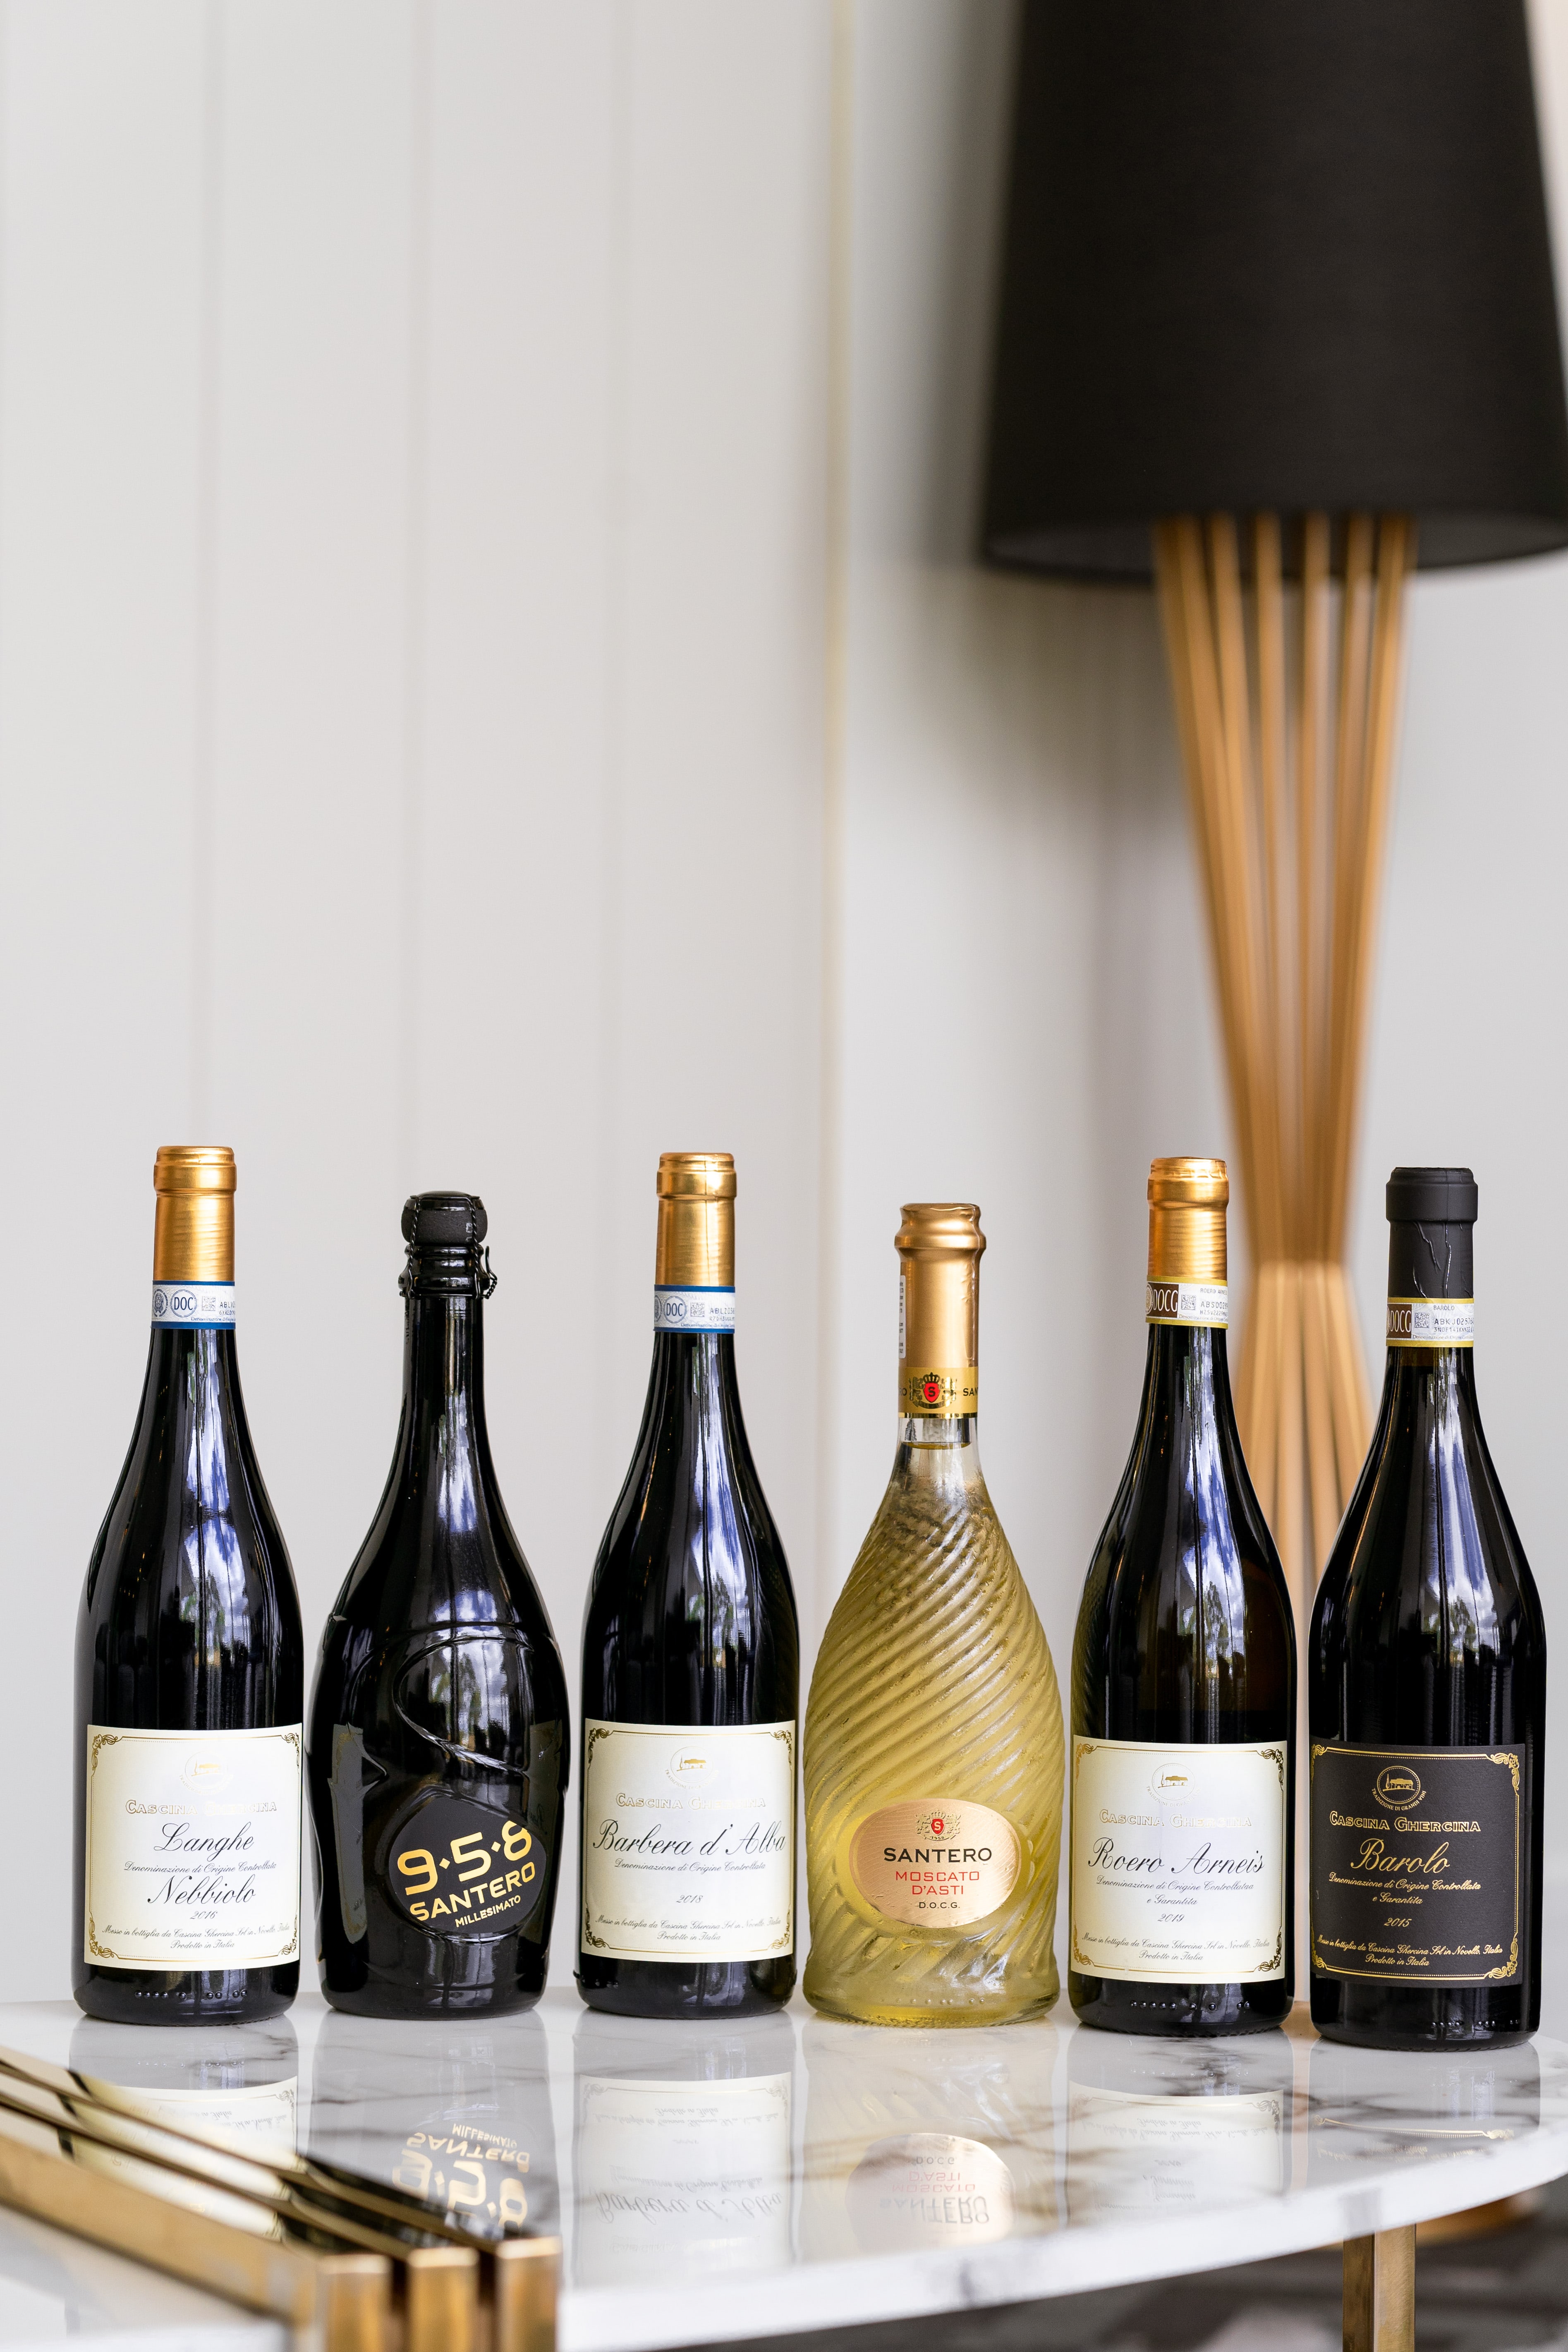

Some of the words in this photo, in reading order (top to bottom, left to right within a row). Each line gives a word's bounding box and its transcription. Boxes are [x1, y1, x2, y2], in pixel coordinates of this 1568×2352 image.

[174, 1297, 193, 1310] DOC
[1154, 1289, 1178, 1312] DOCG
[666, 1303, 683, 1316] DOC
[1391, 1310, 1411, 1332] DOCG
[615, 1793, 683, 1809] CASCINA
[1146, 1786, 1169, 1806] TRADIZIONE
[1372, 1788, 1394, 1810] TRADIZIONE
[1401, 1800, 1420, 1811] GRANDI
[1418, 1790, 1427, 1802] VINI
[125, 1799, 198, 1815] CASCINA
[1099, 1808, 1165, 1827] CASCINA
[1329, 1811, 1390, 1830] CASCINA
[1394, 1817, 1481, 1832] GHERCINA
[934, 1822, 941, 1830] S
[154, 1822, 254, 1861] Langhe
[592, 1819, 694, 1855] Barbera
[884, 1847, 992, 1863] SANTERO
[1088, 1837, 1164, 1872] Roero
[1171, 1842, 1265, 1874] Arneis
[1350, 1838, 1450, 1873] Barolo
[124, 1861, 190, 1874] Denominazione
[192, 1864, 202, 1874] di
[204, 1863, 236, 1875] Origine
[238, 1861, 277, 1873] Controllata
[615, 1858, 676, 1872] Denominazione
[677, 1862, 687, 1872] di
[689, 1862, 722, 1875] Origine
[724, 1861, 766, 1872] Controllata
[896, 1871, 980, 1881] MOSCATO
[1096, 1874, 1154, 1890] Denominazione
[1156, 1880, 1166, 1890] di
[1168, 1881, 1201, 1893] Origine
[1329, 1871, 1383, 1888] Denominazione
[1384, 1879, 1394, 1888] di
[1396, 1878, 1429, 1892] Origine
[1432, 1880, 1481, 1890] Controllata
[147, 1874, 256, 1904] Nebbiolo
[410, 1862, 535, 1921] SANTERO
[912, 1885, 963, 1895] D'ASTI
[676, 1895, 703, 1903] 2018
[1154, 1894, 1197, 1905] Garantita
[1379, 1892, 1423, 1904] Garantita
[190, 1911, 218, 1920] 2016
[455, 1895, 521, 1927] MILLESIMATO
[1157, 1914, 1185, 1923] 2019
[621, 1918, 648, 1929] bottiglia
[649, 1920, 658, 1928] da
[660, 1920, 687, 1930] Cascina
[690, 1920, 721, 1929] Ghercina
[721, 1919, 734, 1929] Srl
[1384, 1918, 1412, 1927] 2015
[132, 1930, 160, 1939] bottiglia
[173, 1929, 202, 1938] Cascina
[204, 1929, 236, 1938] Ghercina
[236, 1927, 248, 1936] Srl
[657, 1931, 689, 1940] Prodotto
[699, 1932, 721, 1940] Italia
[1081, 1932, 1098, 1943] Messo
[1098, 1935, 1104, 1944] in
[1104, 1935, 1129, 1947] bottiglia
[1142, 1939, 1169, 1949] Cascina
[1172, 1940, 1203, 1950] Ghercina
[1204, 1940, 1217, 1950] Srl
[1253, 1938, 1270, 1948] Italia
[1317, 1934, 1329, 1945] Messo
[1335, 1938, 1357, 1952] bottiglia
[1357, 1942, 1367, 1951] da
[1368, 1942, 1395, 1954] Cascina
[1397, 1944, 1429, 1955] Ghercina
[1429, 1945, 1446, 1955] Srl
[1483, 1944, 1503, 1954] Italia
[1138, 1950, 1171, 1960] Prodotto
[1180, 1952, 1204, 1960] Italia
[1365, 1954, 1396, 1965] Prodotto
[1405, 1956, 1430, 1966] Italia
